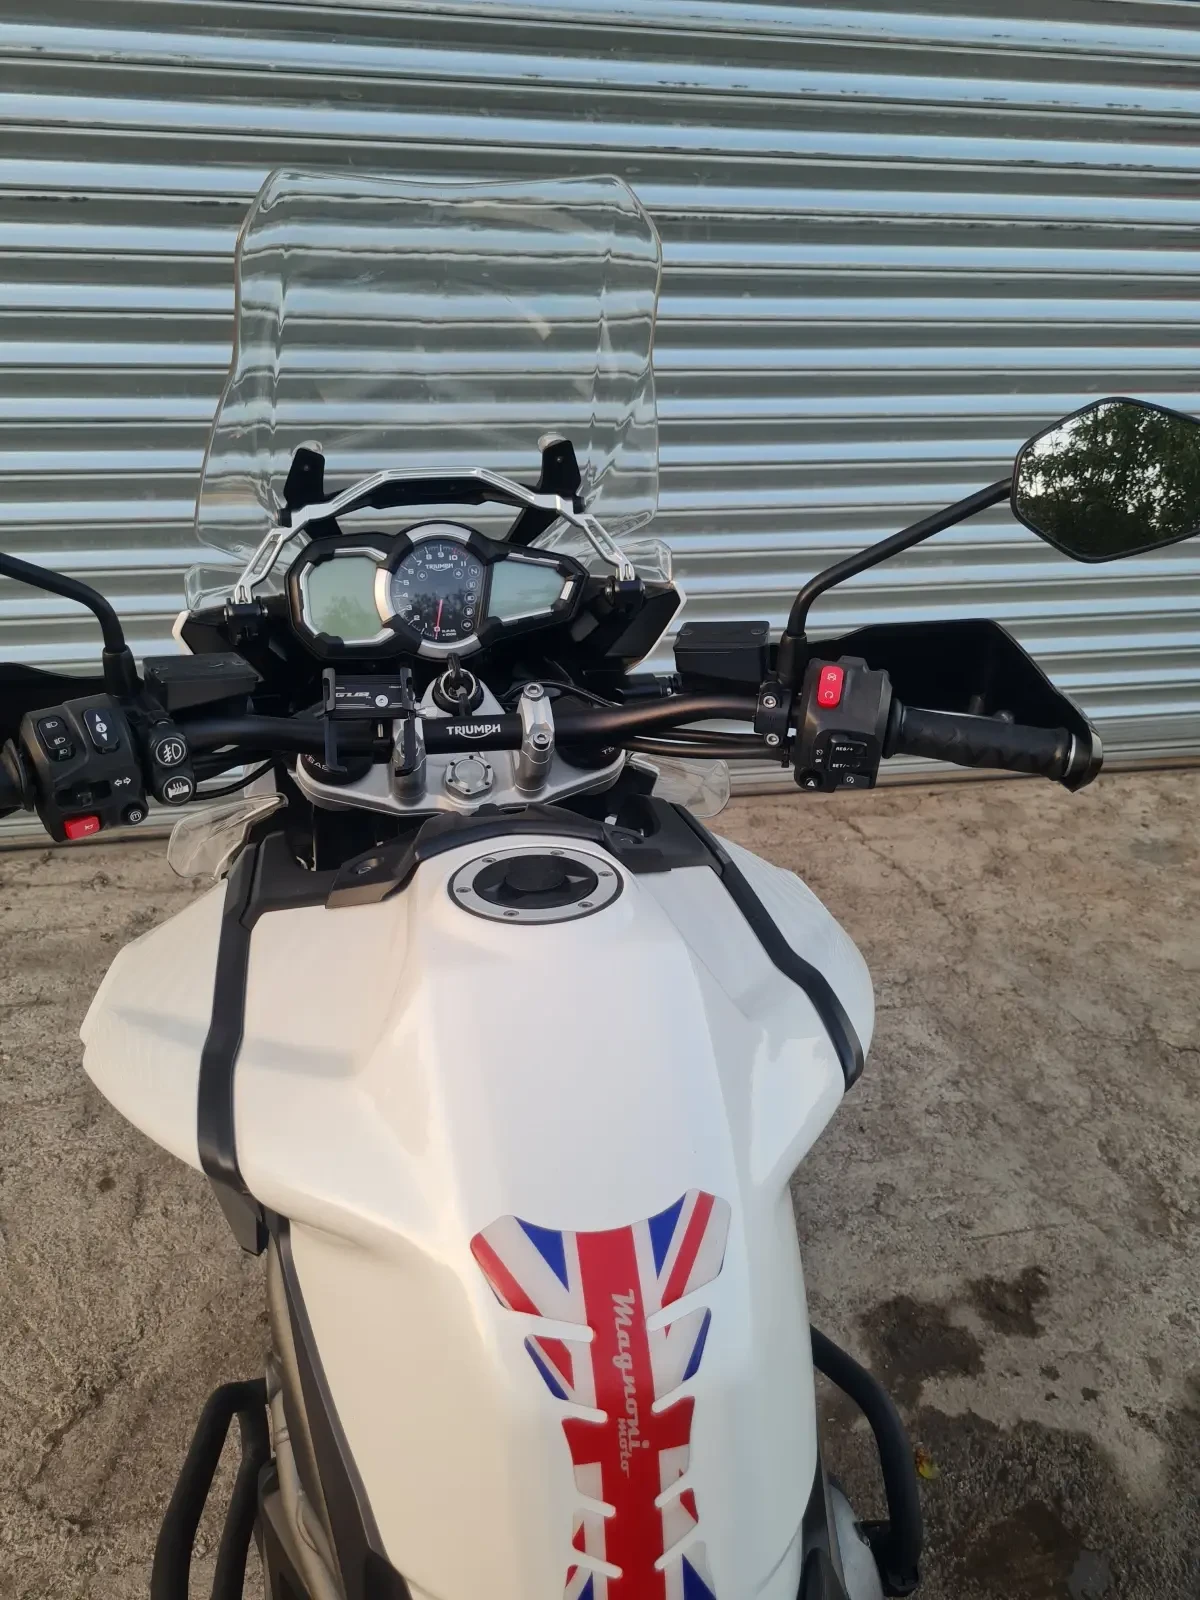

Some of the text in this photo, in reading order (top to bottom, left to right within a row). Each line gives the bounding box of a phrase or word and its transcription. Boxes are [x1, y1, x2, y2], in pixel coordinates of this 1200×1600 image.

[425, 563, 454, 571] TRIUMPH
[446, 724, 501, 738] TRIUMPH
[611, 1288, 650, 1452] Magnoni
